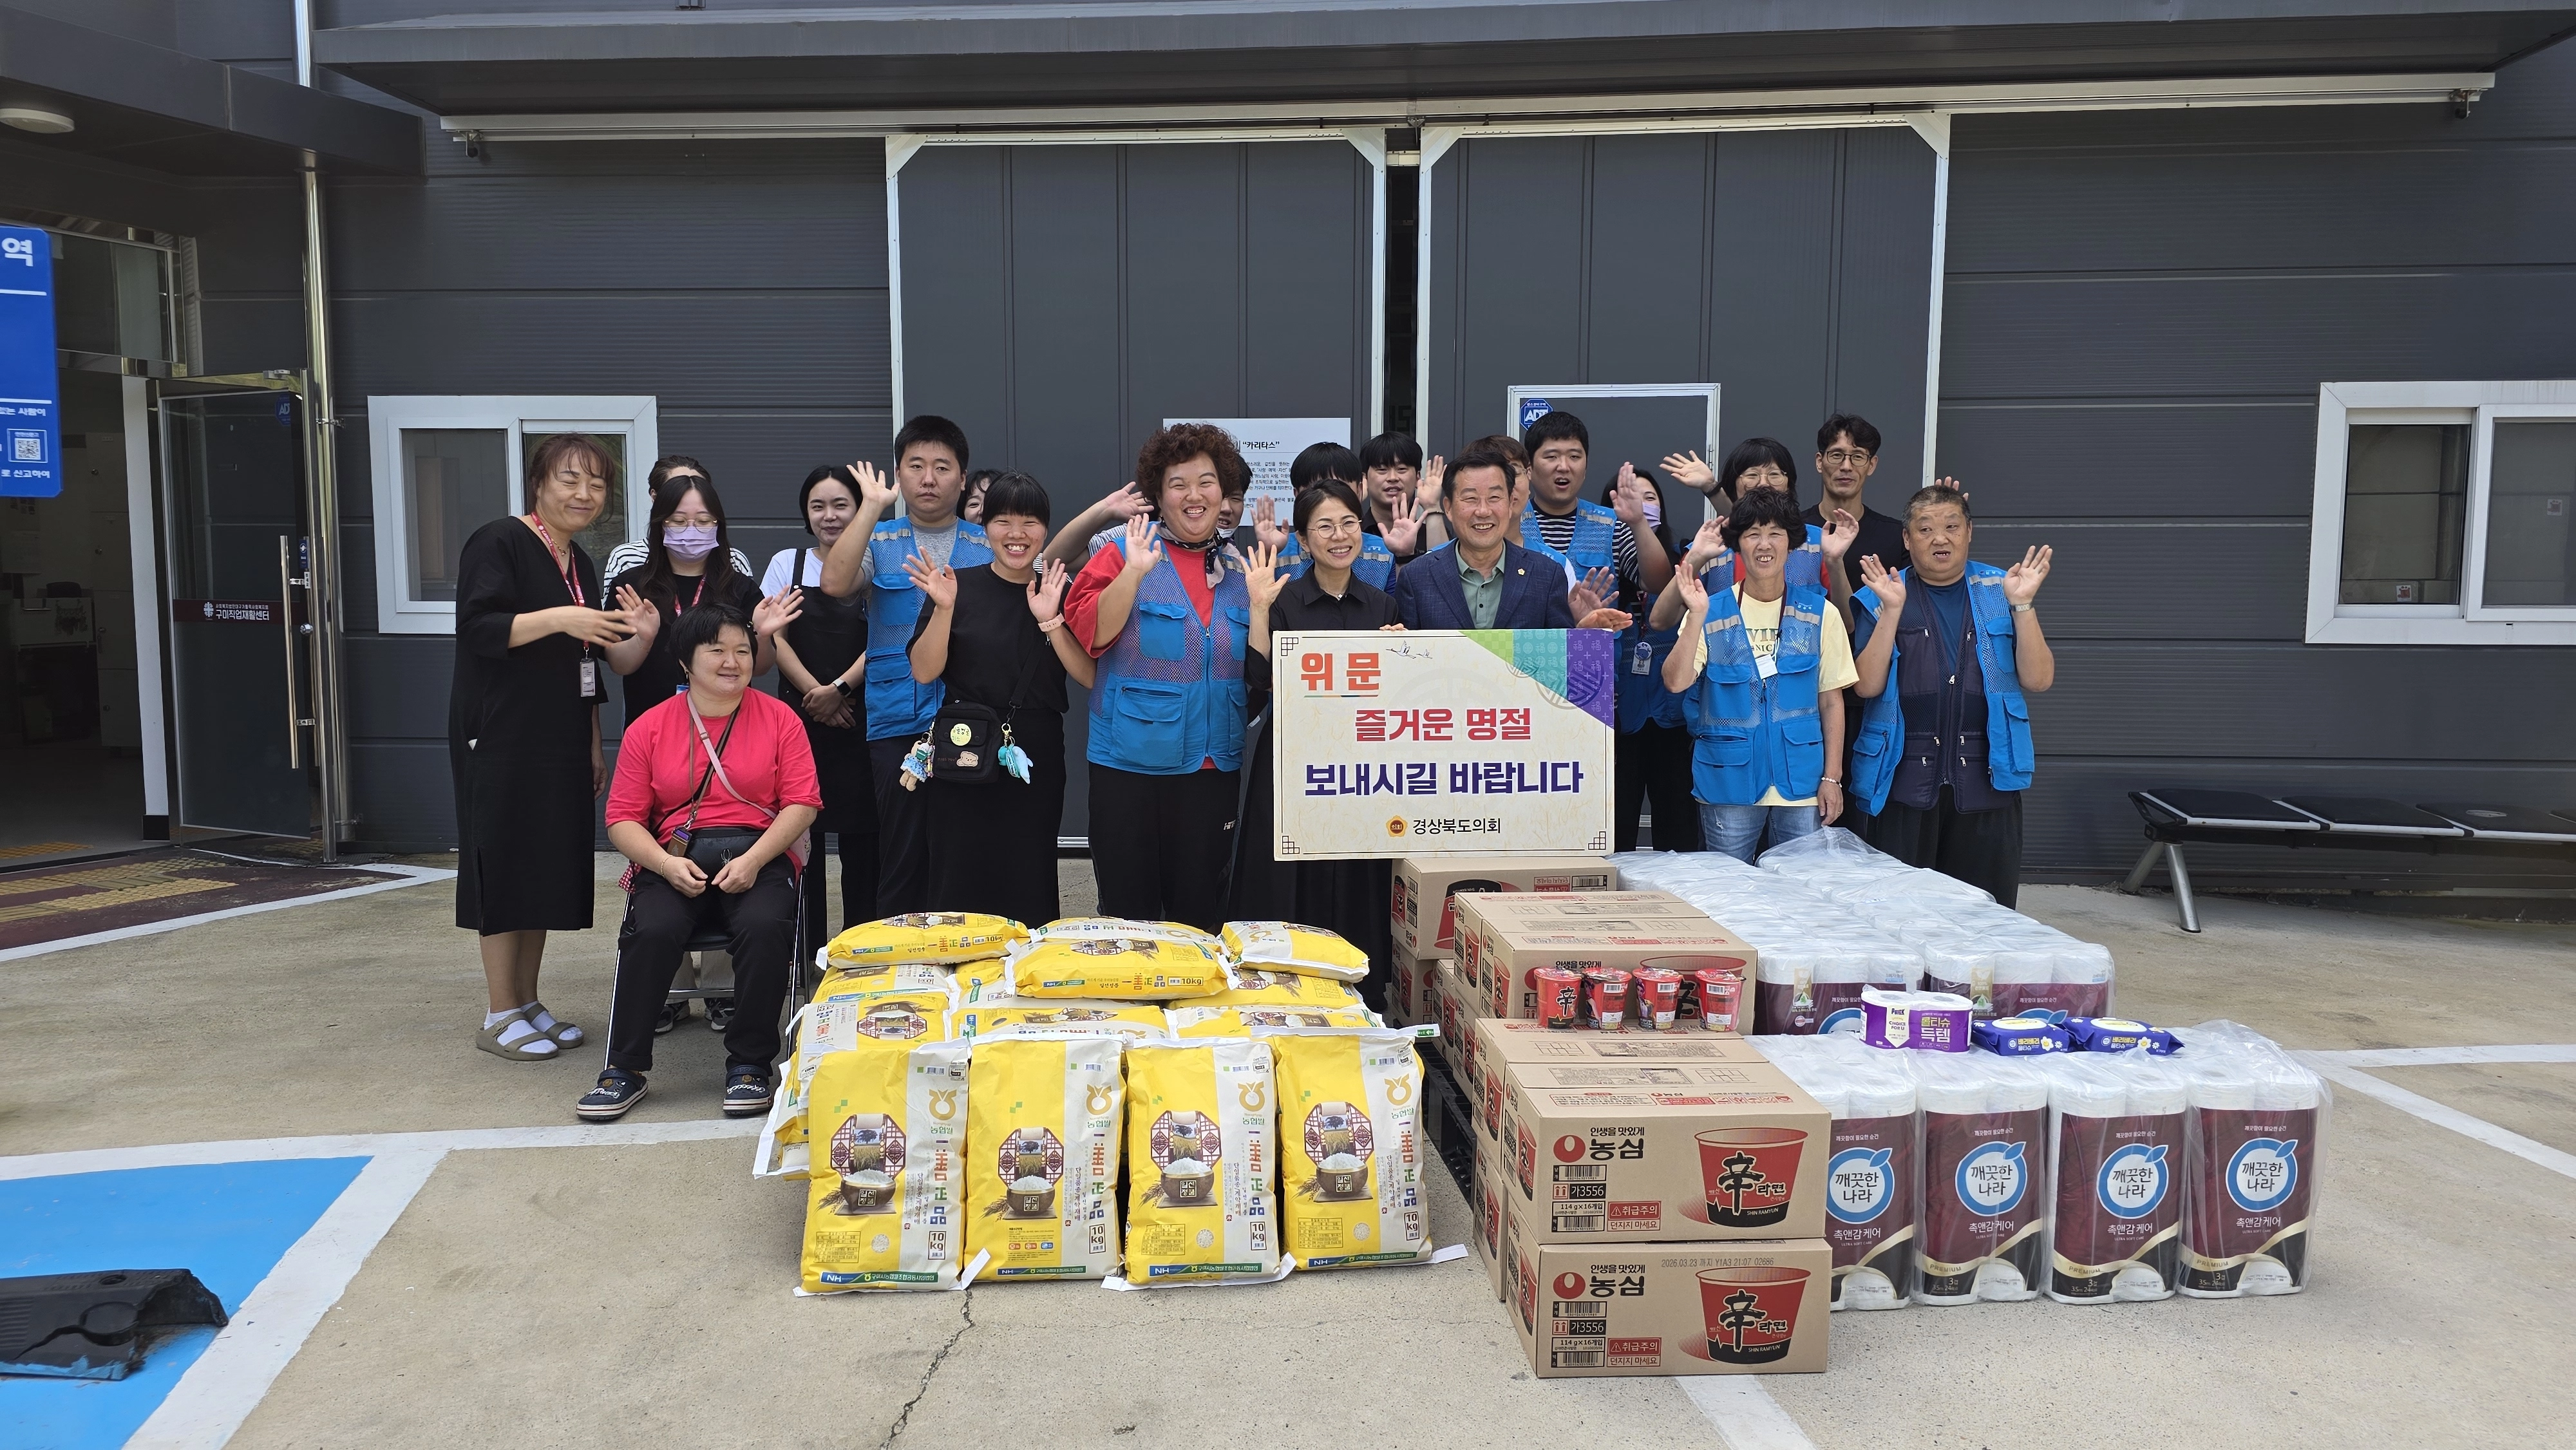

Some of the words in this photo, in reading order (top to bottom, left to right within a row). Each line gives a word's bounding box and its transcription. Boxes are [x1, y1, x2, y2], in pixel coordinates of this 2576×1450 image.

[2, 238, 33, 267] 역
[14, 470, 50, 478] 신고하여
[216, 610, 269, 621] 구미직업재활센터
[1301, 653, 1332, 690] 위
[1347, 653, 1381, 690] 문
[1355, 709, 1454, 741] 즐거운
[1466, 708, 1531, 740] 명절
[1305, 762, 1437, 796] 보내시길
[1450, 761, 1584, 794] 바랍니다
[1413, 818, 1501, 834] 경상북도의회
[1557, 986, 1576, 1017] 辛
[1921, 1028, 1950, 1042] 득템
[1391, 1107, 1414, 1119] 농협쌀
[1088, 1120, 1111, 1128] 농협쌀
[931, 1126, 953, 1135] 농협쌀
[1590, 1127, 1616, 1136] 인생을
[1618, 1127, 1644, 1136] 맛있게
[1589, 1138, 1644, 1160] 농심
[1971, 1164, 2012, 1182] 깨끗한
[2112, 1167, 2154, 1183] 깨끗한
[2242, 1162, 2283, 1177] 깨끗한
[1718, 1151, 1766, 1216] 辛
[1835, 1172, 1879, 1189] 깨끗한
[2248, 1178, 2275, 1192] 나라
[1571, 1185, 1604, 1197] 가3556
[1756, 1182, 1786, 1197] 라면
[1979, 1182, 2006, 1196] 나라
[2118, 1184, 2146, 1198] 나라
[1843, 1189, 1872, 1203] 나라
[1622, 1205, 1657, 1215] 취급주의
[1406, 1214, 1417, 1222] 10
[2236, 1217, 2262, 1228] 촉앤감
[2262, 1216, 2281, 1227] 케어
[1092, 1226, 1103, 1234] 10
[1253, 1223, 1264, 1232] 10
[1406, 1223, 1417, 1231] kg
[1634, 1221, 1657, 1229] 마세요
[1969, 1221, 1994, 1233] 촉앤감
[1994, 1220, 2014, 1231] 케어
[2107, 1223, 2136, 1235] 촉앤감
[2136, 1223, 2153, 1234] 케어
[932, 1233, 944, 1241] 10
[1091, 1235, 1104, 1245] kg
[1253, 1232, 1265, 1241] kg
[1833, 1229, 1862, 1241] 촉앤감
[1863, 1227, 1881, 1239] 케어
[930, 1242, 943, 1250] kg
[1662, 1259, 1698, 1267] 2026.03.23
[1715, 1258, 1732, 1266] Y1A3
[1754, 1257, 1774, 1266] 02686
[1930, 1264, 1962, 1272] PREMIUM
[1591, 1265, 1616, 1274] 인생을
[1618, 1265, 1645, 1274] 맛있게
[1589, 1276, 1644, 1297] 농심
[1718, 1289, 1767, 1352] 辛
[1571, 1322, 1604, 1333] 가3556
[1757, 1320, 1788, 1334] 라면
[1622, 1342, 1658, 1351] 취급주의
